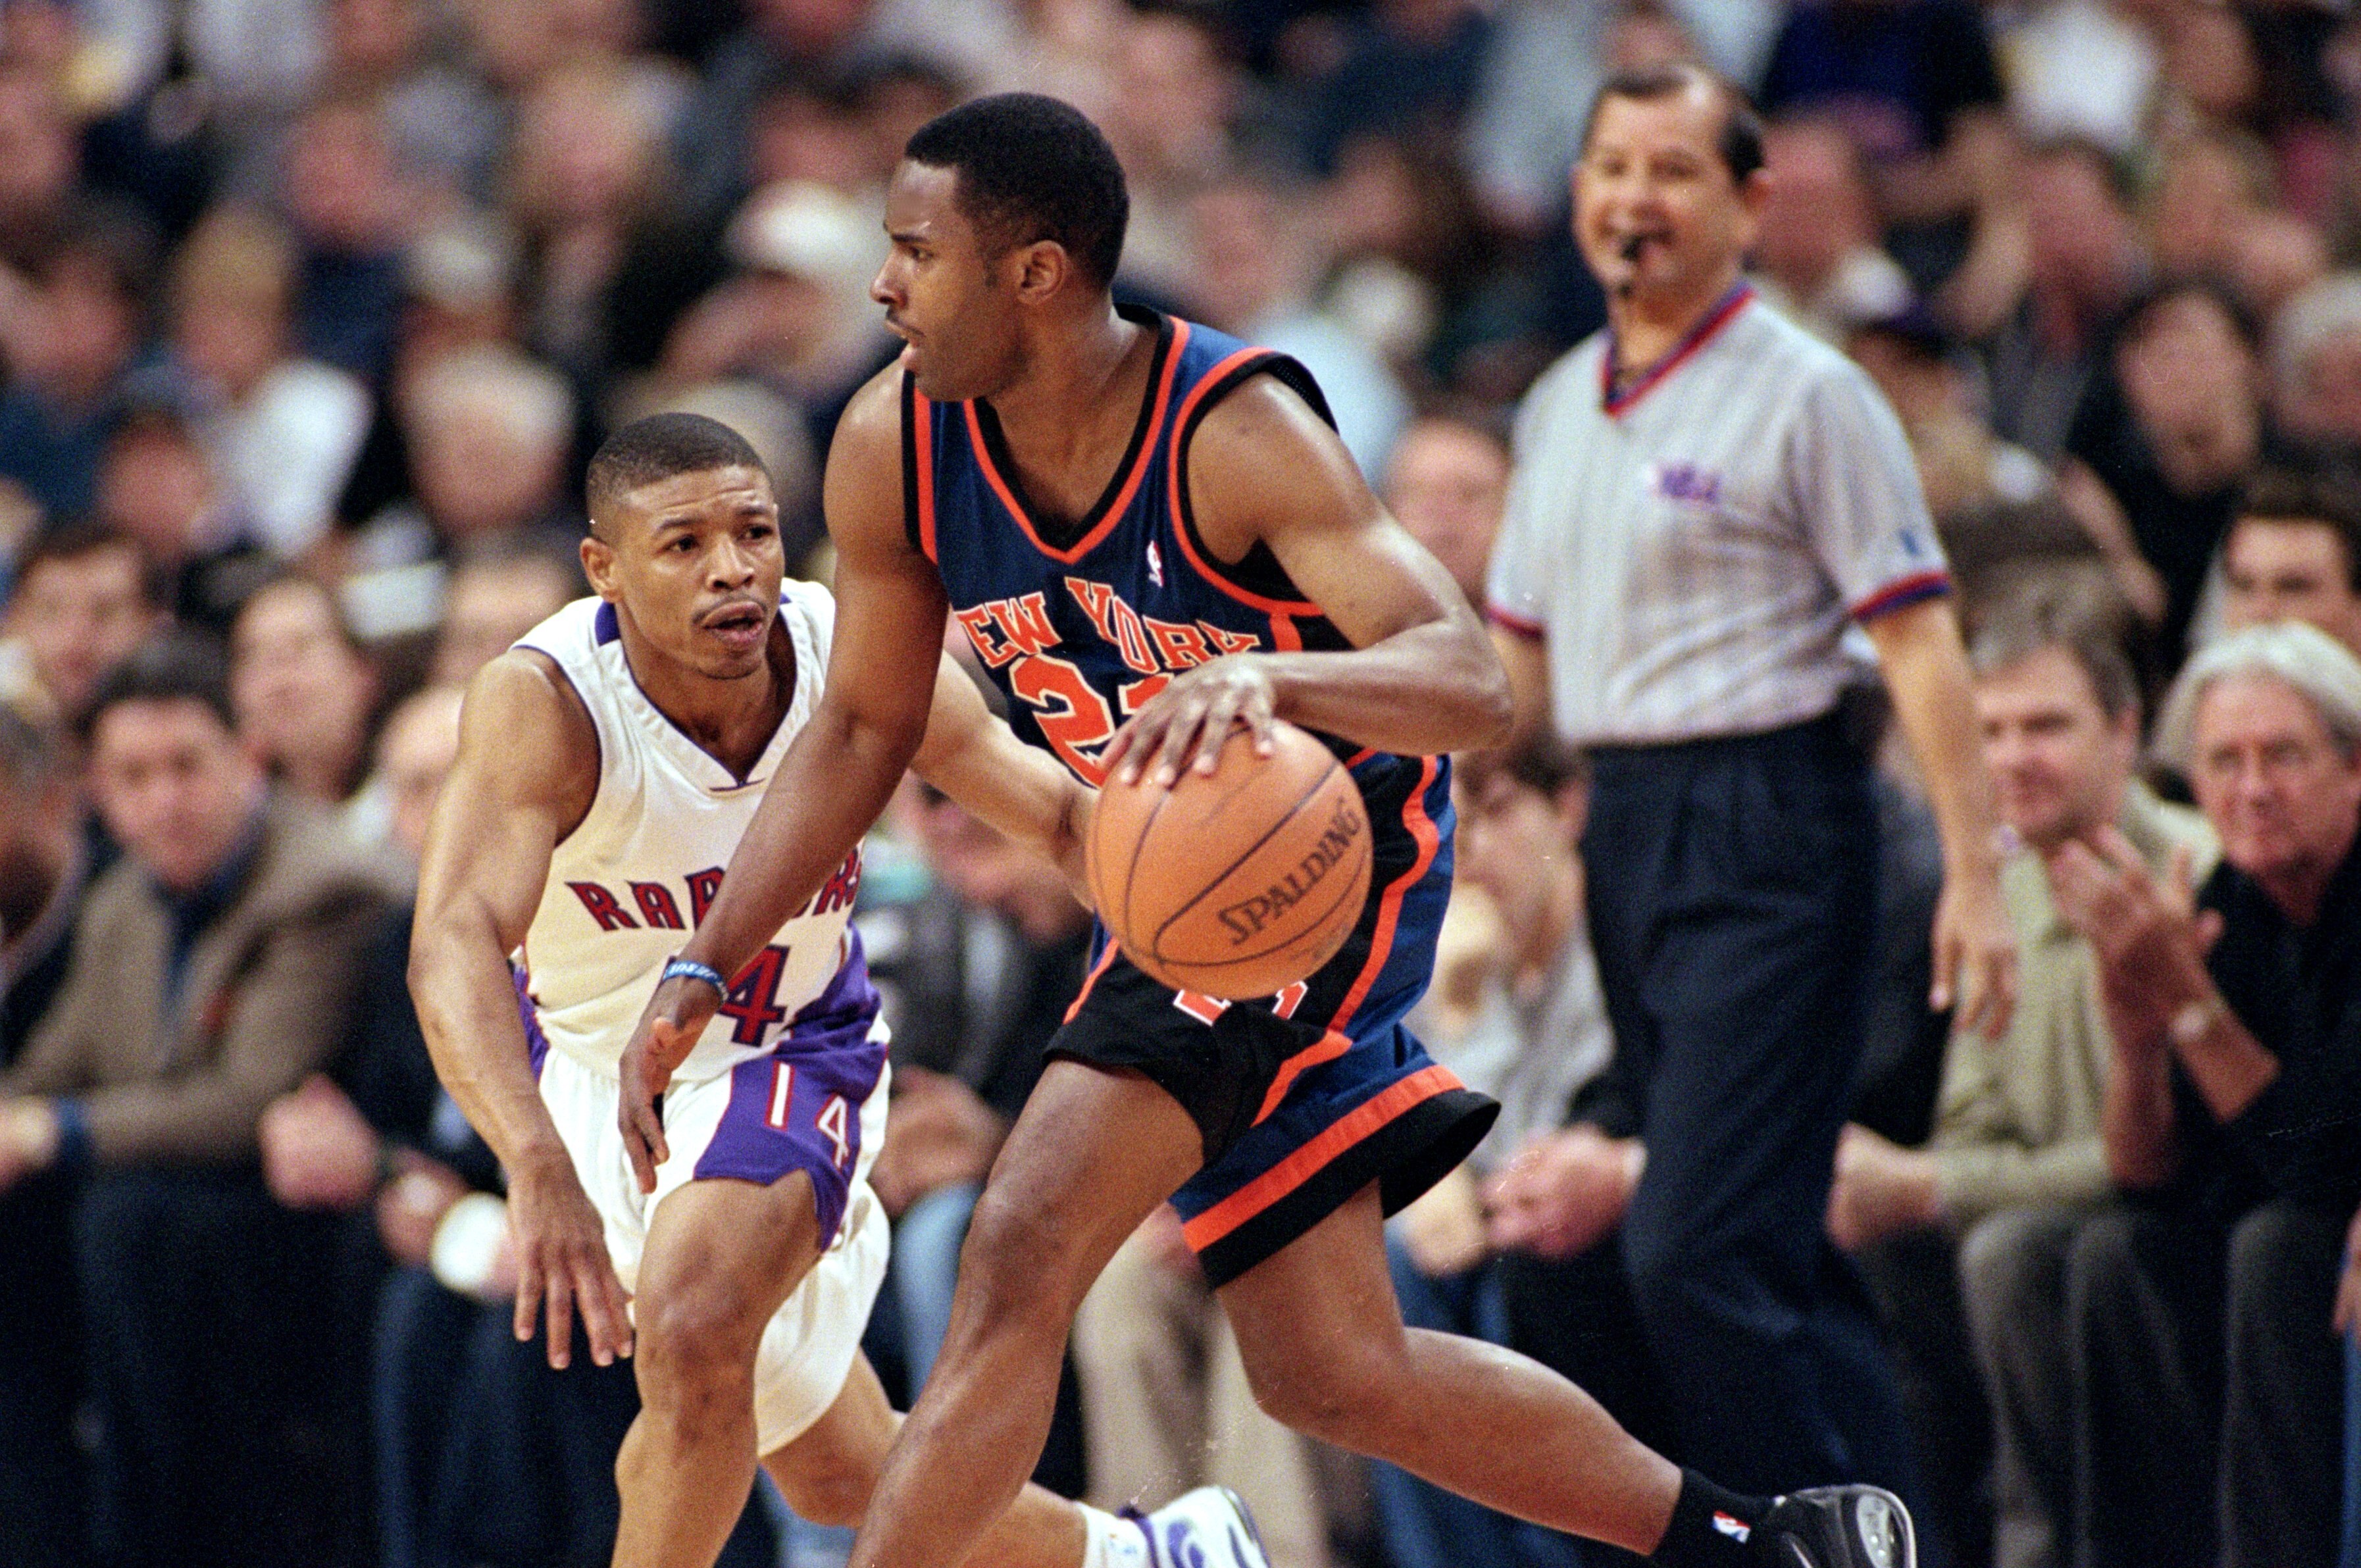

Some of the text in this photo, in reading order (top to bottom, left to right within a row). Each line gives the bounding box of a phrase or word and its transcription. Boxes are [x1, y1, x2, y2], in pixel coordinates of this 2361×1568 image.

[953, 575, 1261, 674] EW YORK
[1008, 653, 1175, 791] 2
[1217, 796, 1362, 946] SPALDING
[763, 1059, 851, 1173] 14
